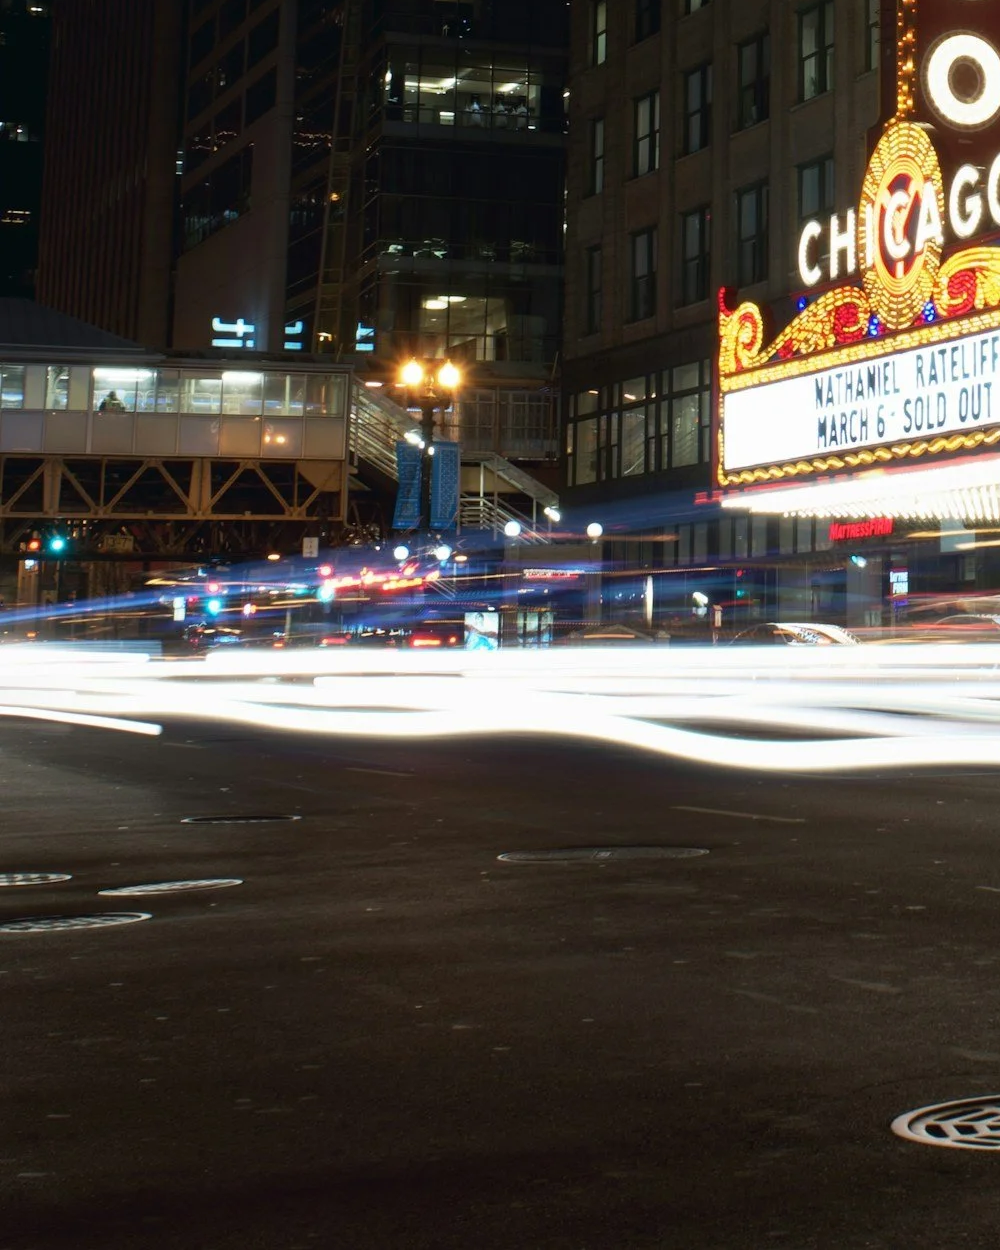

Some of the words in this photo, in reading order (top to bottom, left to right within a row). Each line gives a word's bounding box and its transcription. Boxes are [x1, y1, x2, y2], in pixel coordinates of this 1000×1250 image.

[814, 360, 900, 410] NATHANIEL
[915, 335, 1000, 387] RATELIFF
[817, 410, 869, 449] MARCH
[903, 392, 947, 433] SOLD
[958, 380, 993, 422] OUT
